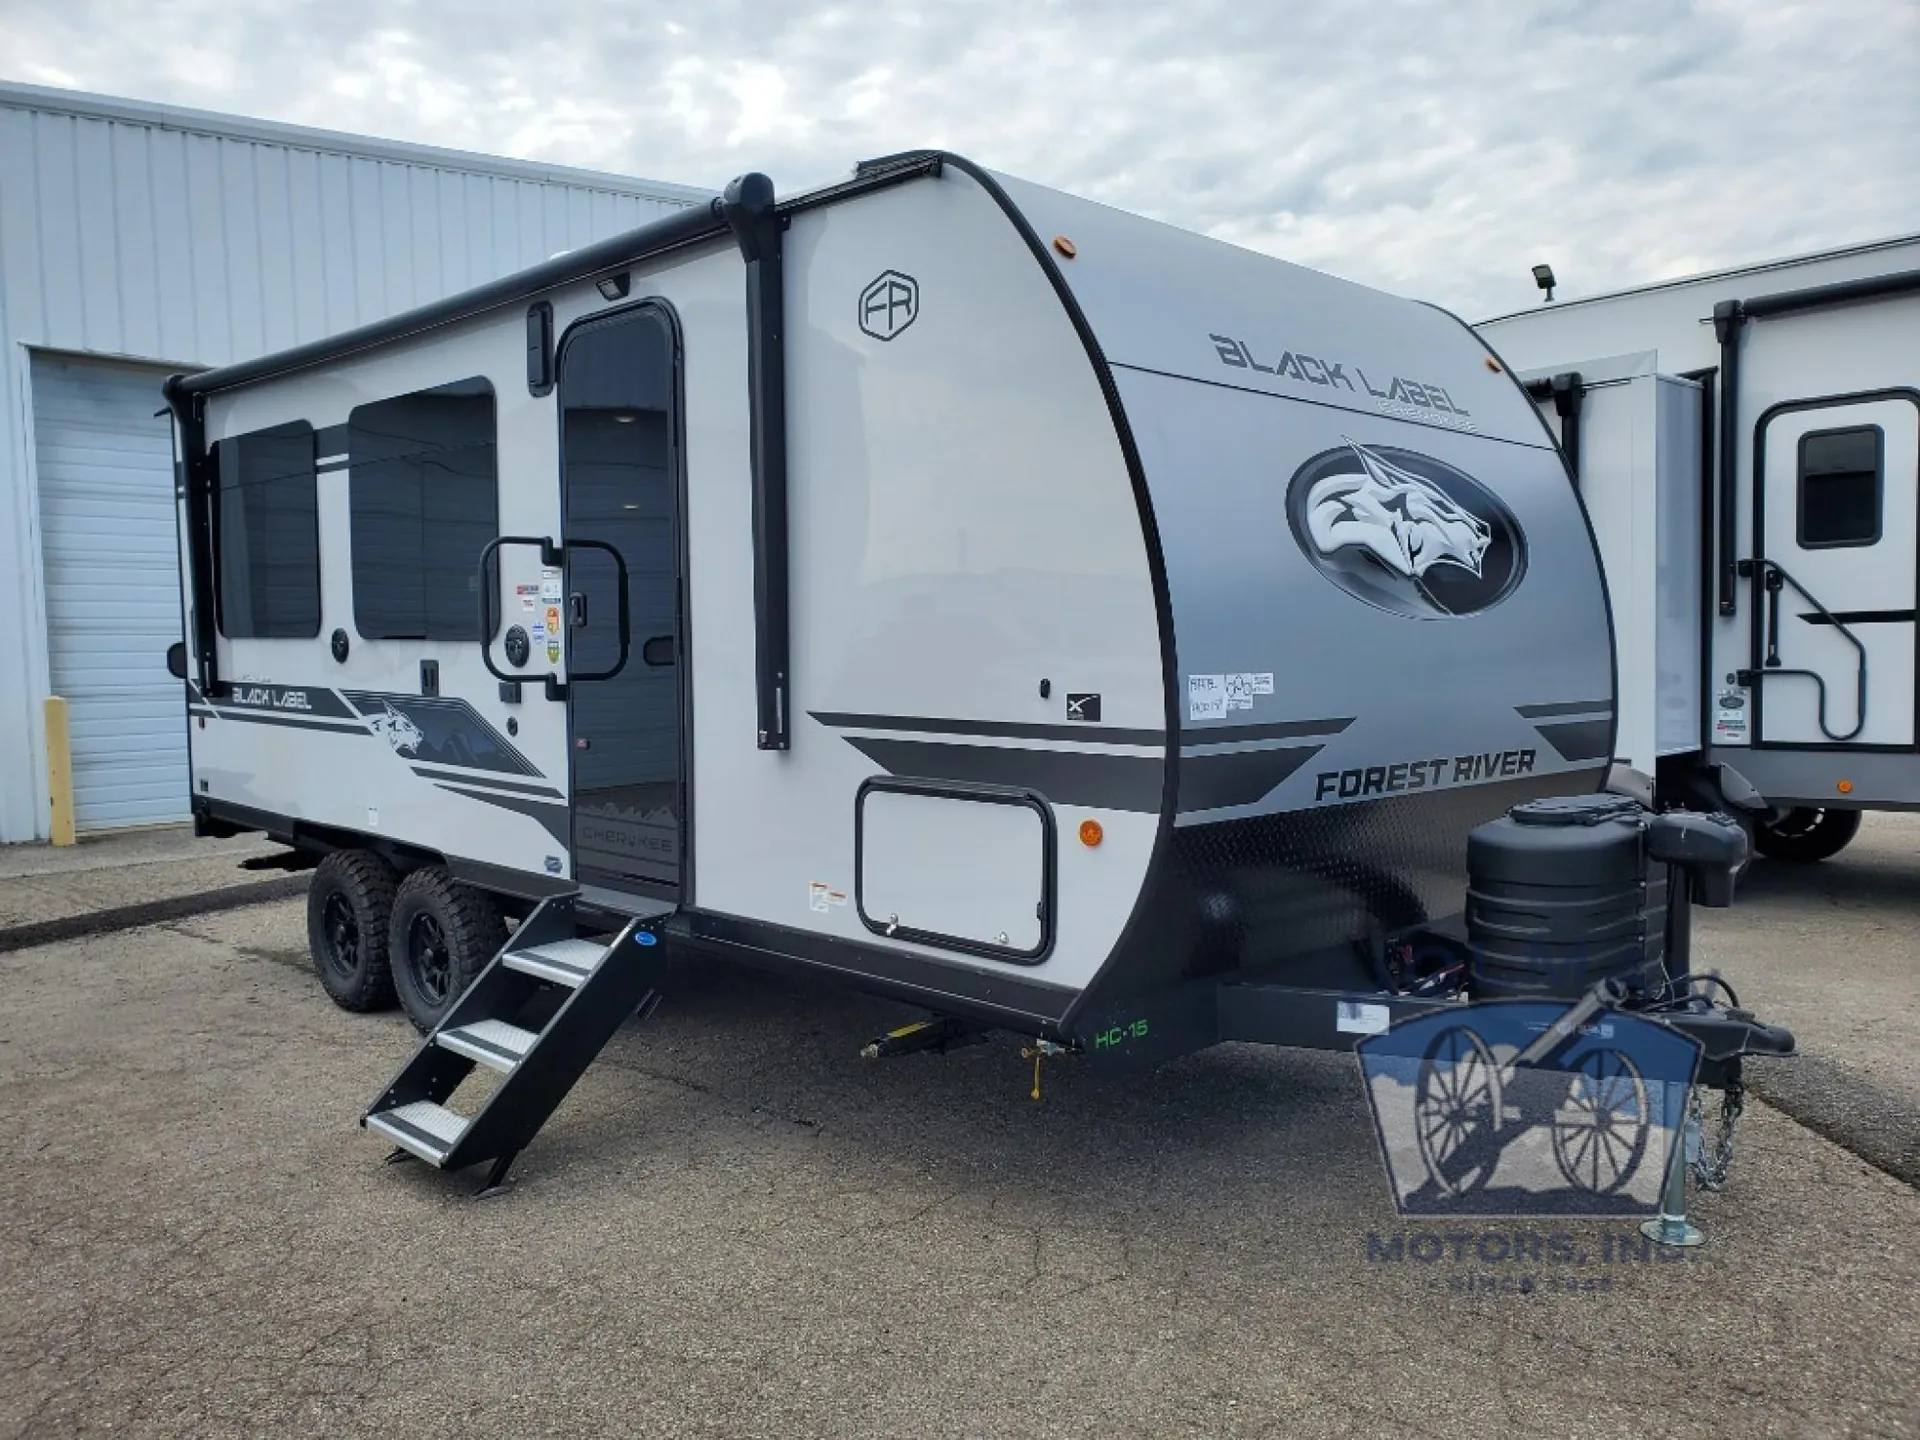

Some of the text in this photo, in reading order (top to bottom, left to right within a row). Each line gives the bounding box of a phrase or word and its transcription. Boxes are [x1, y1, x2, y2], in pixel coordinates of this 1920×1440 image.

[1208, 332, 1355, 392] BLACK
[1355, 366, 1470, 416] LABEL
[231, 686, 313, 710] BLACK LABEL
[1315, 749, 1537, 801] FOREST RIVER
